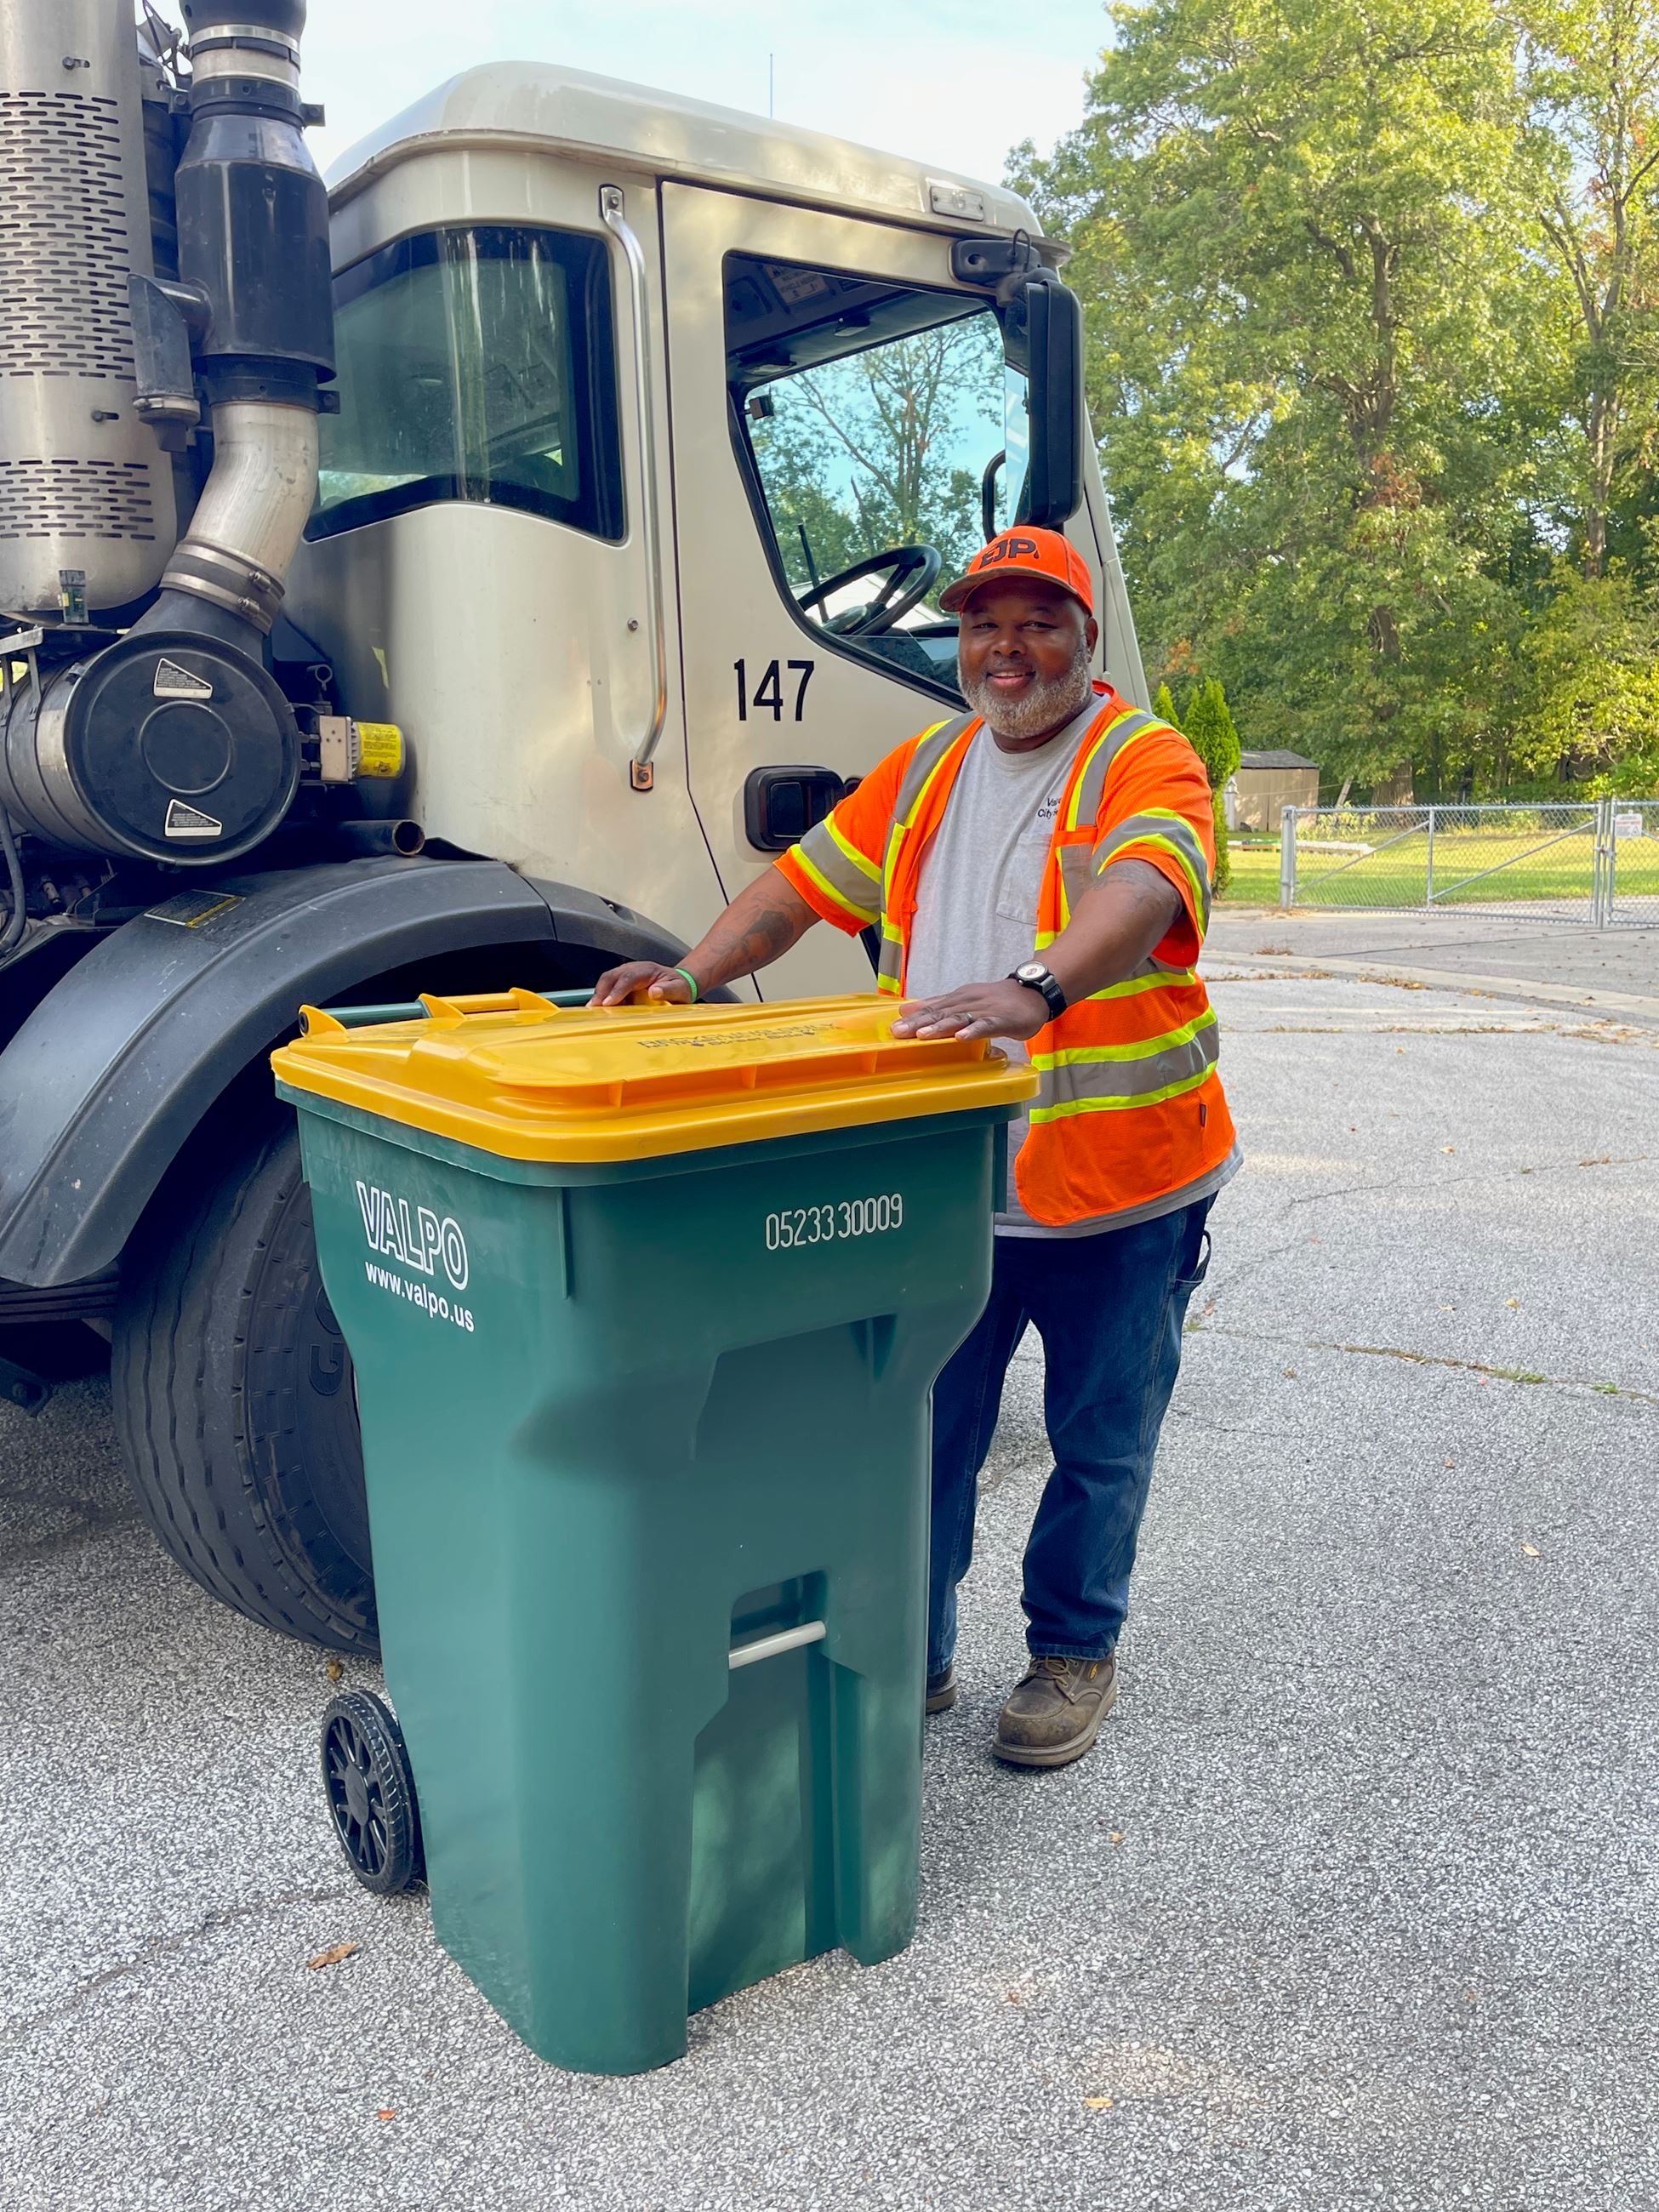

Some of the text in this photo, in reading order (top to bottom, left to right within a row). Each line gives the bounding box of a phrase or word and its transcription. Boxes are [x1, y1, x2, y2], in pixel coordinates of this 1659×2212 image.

[978, 538, 1036, 569] EJP
[733, 658, 814, 721] 147
[356, 1180, 469, 1291] VALPO
[365, 1261, 475, 1332] www.valpo.us
